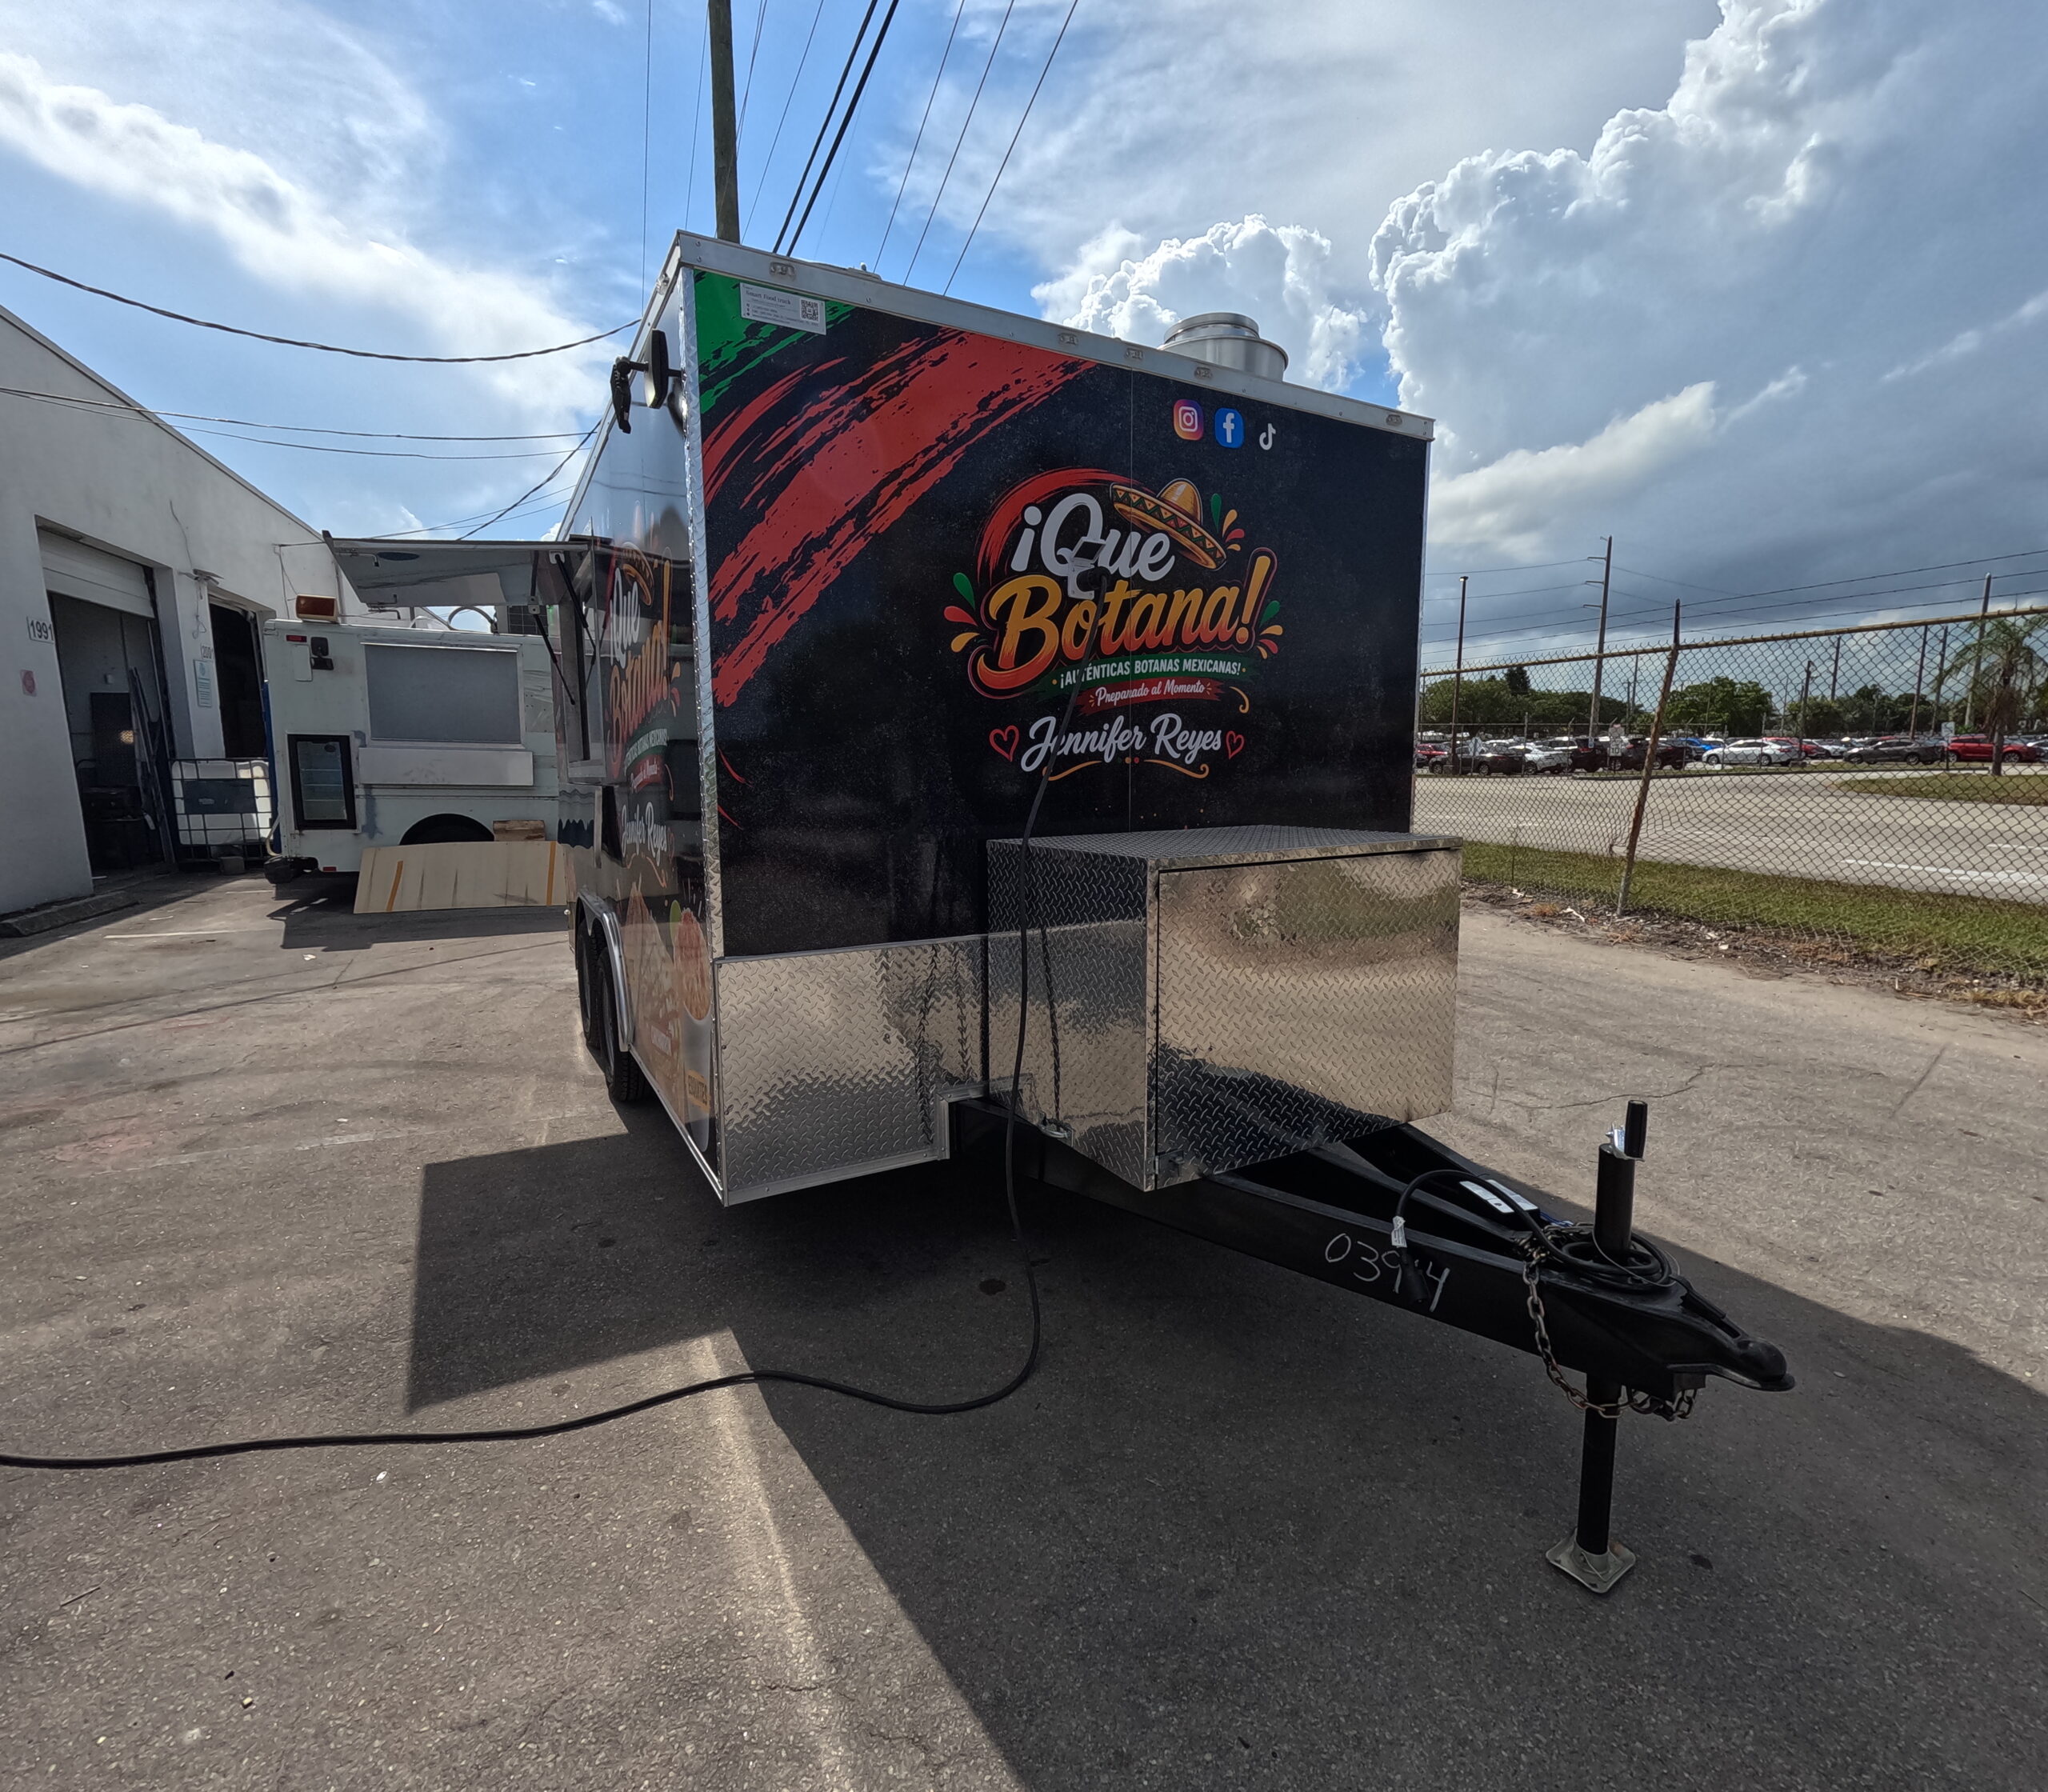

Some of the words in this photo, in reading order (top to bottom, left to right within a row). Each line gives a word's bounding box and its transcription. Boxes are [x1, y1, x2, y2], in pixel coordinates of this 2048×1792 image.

[1010, 493, 1174, 581] ¡Que
[30, 620, 54, 641] 1991
[977, 555, 1271, 690] Botana!
[1134, 658, 1179, 674] BOTANAS
[1182, 658, 1241, 675] MEXICANAS!
[1095, 683, 1150, 706] Preparado
[1151, 681, 1162, 694] al
[1163, 678, 1206, 695] Momento
[1150, 713, 1222, 765] Reyes
